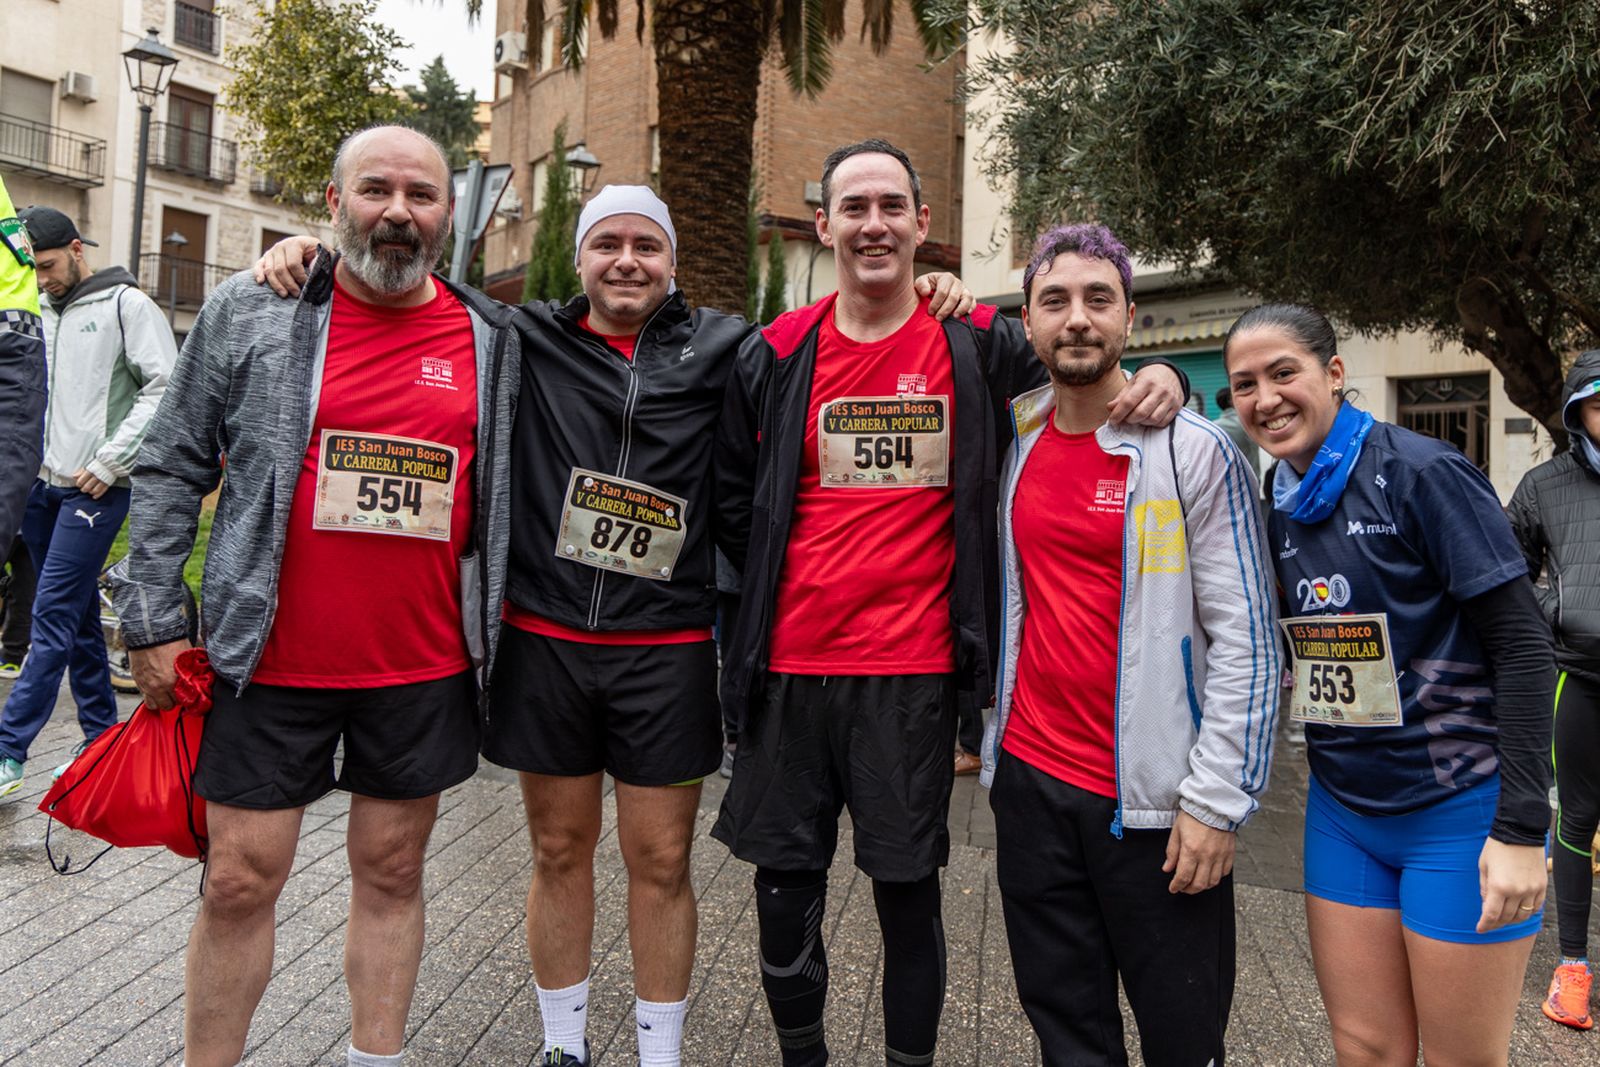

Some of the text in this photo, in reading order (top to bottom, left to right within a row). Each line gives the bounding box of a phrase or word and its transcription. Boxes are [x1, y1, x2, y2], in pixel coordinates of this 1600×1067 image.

[831, 402, 935, 416] IES San Juan Bosco
[828, 417, 939, 431] V CARRERA POPULAR
[335, 439, 447, 463] IES San Juan Bosco
[854, 436, 914, 470] 564
[331, 453, 448, 480] V CARRERA POPULAR
[356, 476, 423, 516] 554
[600, 482, 622, 498] San
[622, 488, 649, 505] Juan
[575, 491, 679, 529] V CARRERA POPULAR
[590, 516, 653, 559] 878
[1296, 573, 1351, 612] 200
[1292, 624, 1372, 639] IES San Juan Bosco
[1295, 641, 1380, 658] V CARRERA POPULAR
[1308, 663, 1356, 705] 553
